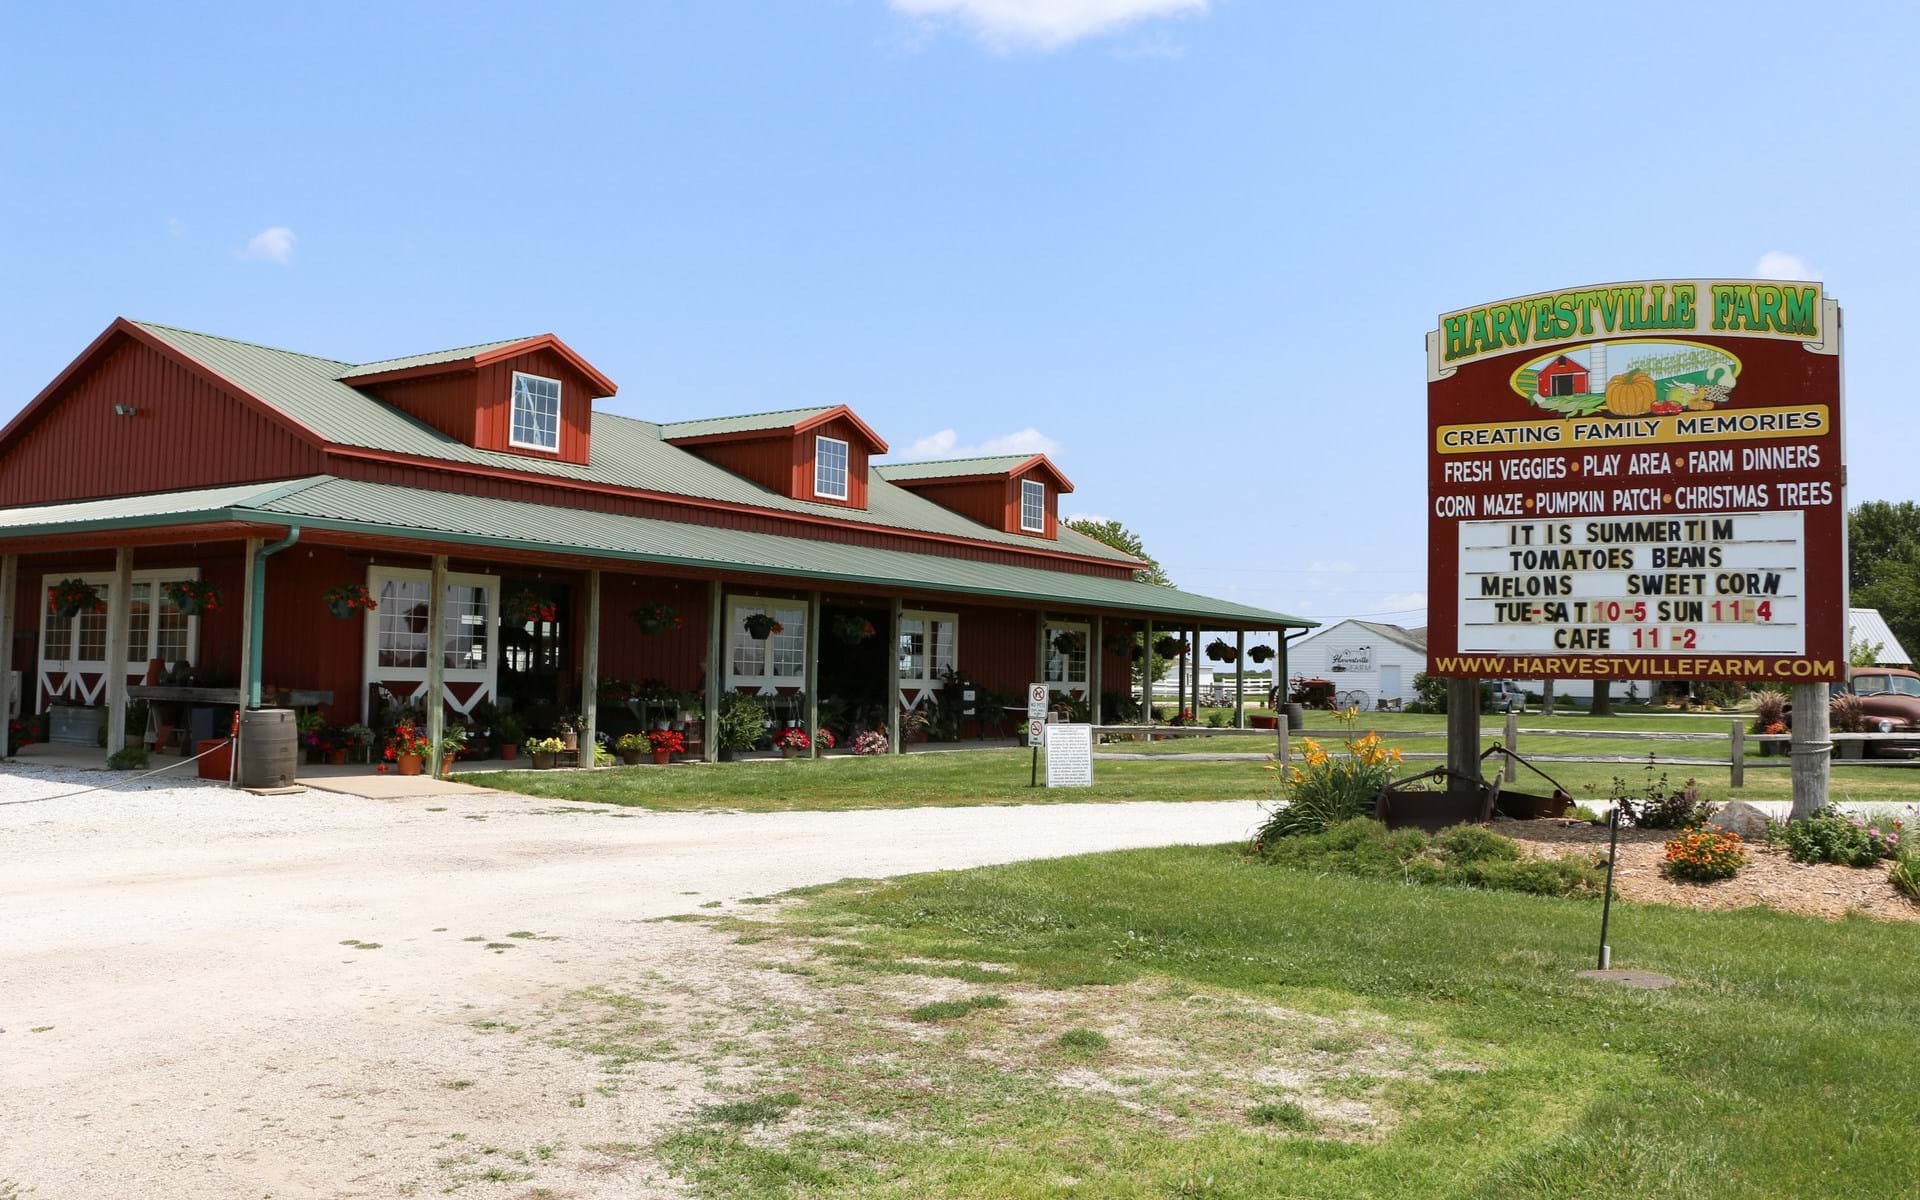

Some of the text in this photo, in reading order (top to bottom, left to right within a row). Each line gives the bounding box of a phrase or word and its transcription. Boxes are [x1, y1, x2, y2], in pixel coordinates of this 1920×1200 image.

[1444, 284, 1817, 361] HARVESTVILLE FARM
[1443, 411, 1822, 446] CREATING FAMILY MEMORIES
[1444, 445, 1820, 482] FRESH VEGGIES PLAY AREA FARM DINNERS
[1435, 481, 1833, 517] CORN MAZE PUMPKIN PATCH CHRISTMAS TREES
[1511, 525, 1534, 545] IT
[1548, 524, 1572, 544] IS
[1510, 546, 1722, 571] TOMATOES BEANS
[1481, 572, 1781, 597] MELONS SWEET CORN
[1594, 601, 1646, 622] 10-5
[1657, 601, 1703, 622] SUN
[1711, 600, 1772, 621] 11-4
[1554, 628, 1610, 649] CAFE
[1435, 657, 1835, 677] WWW.HARVESTVILLEFARM.COM
